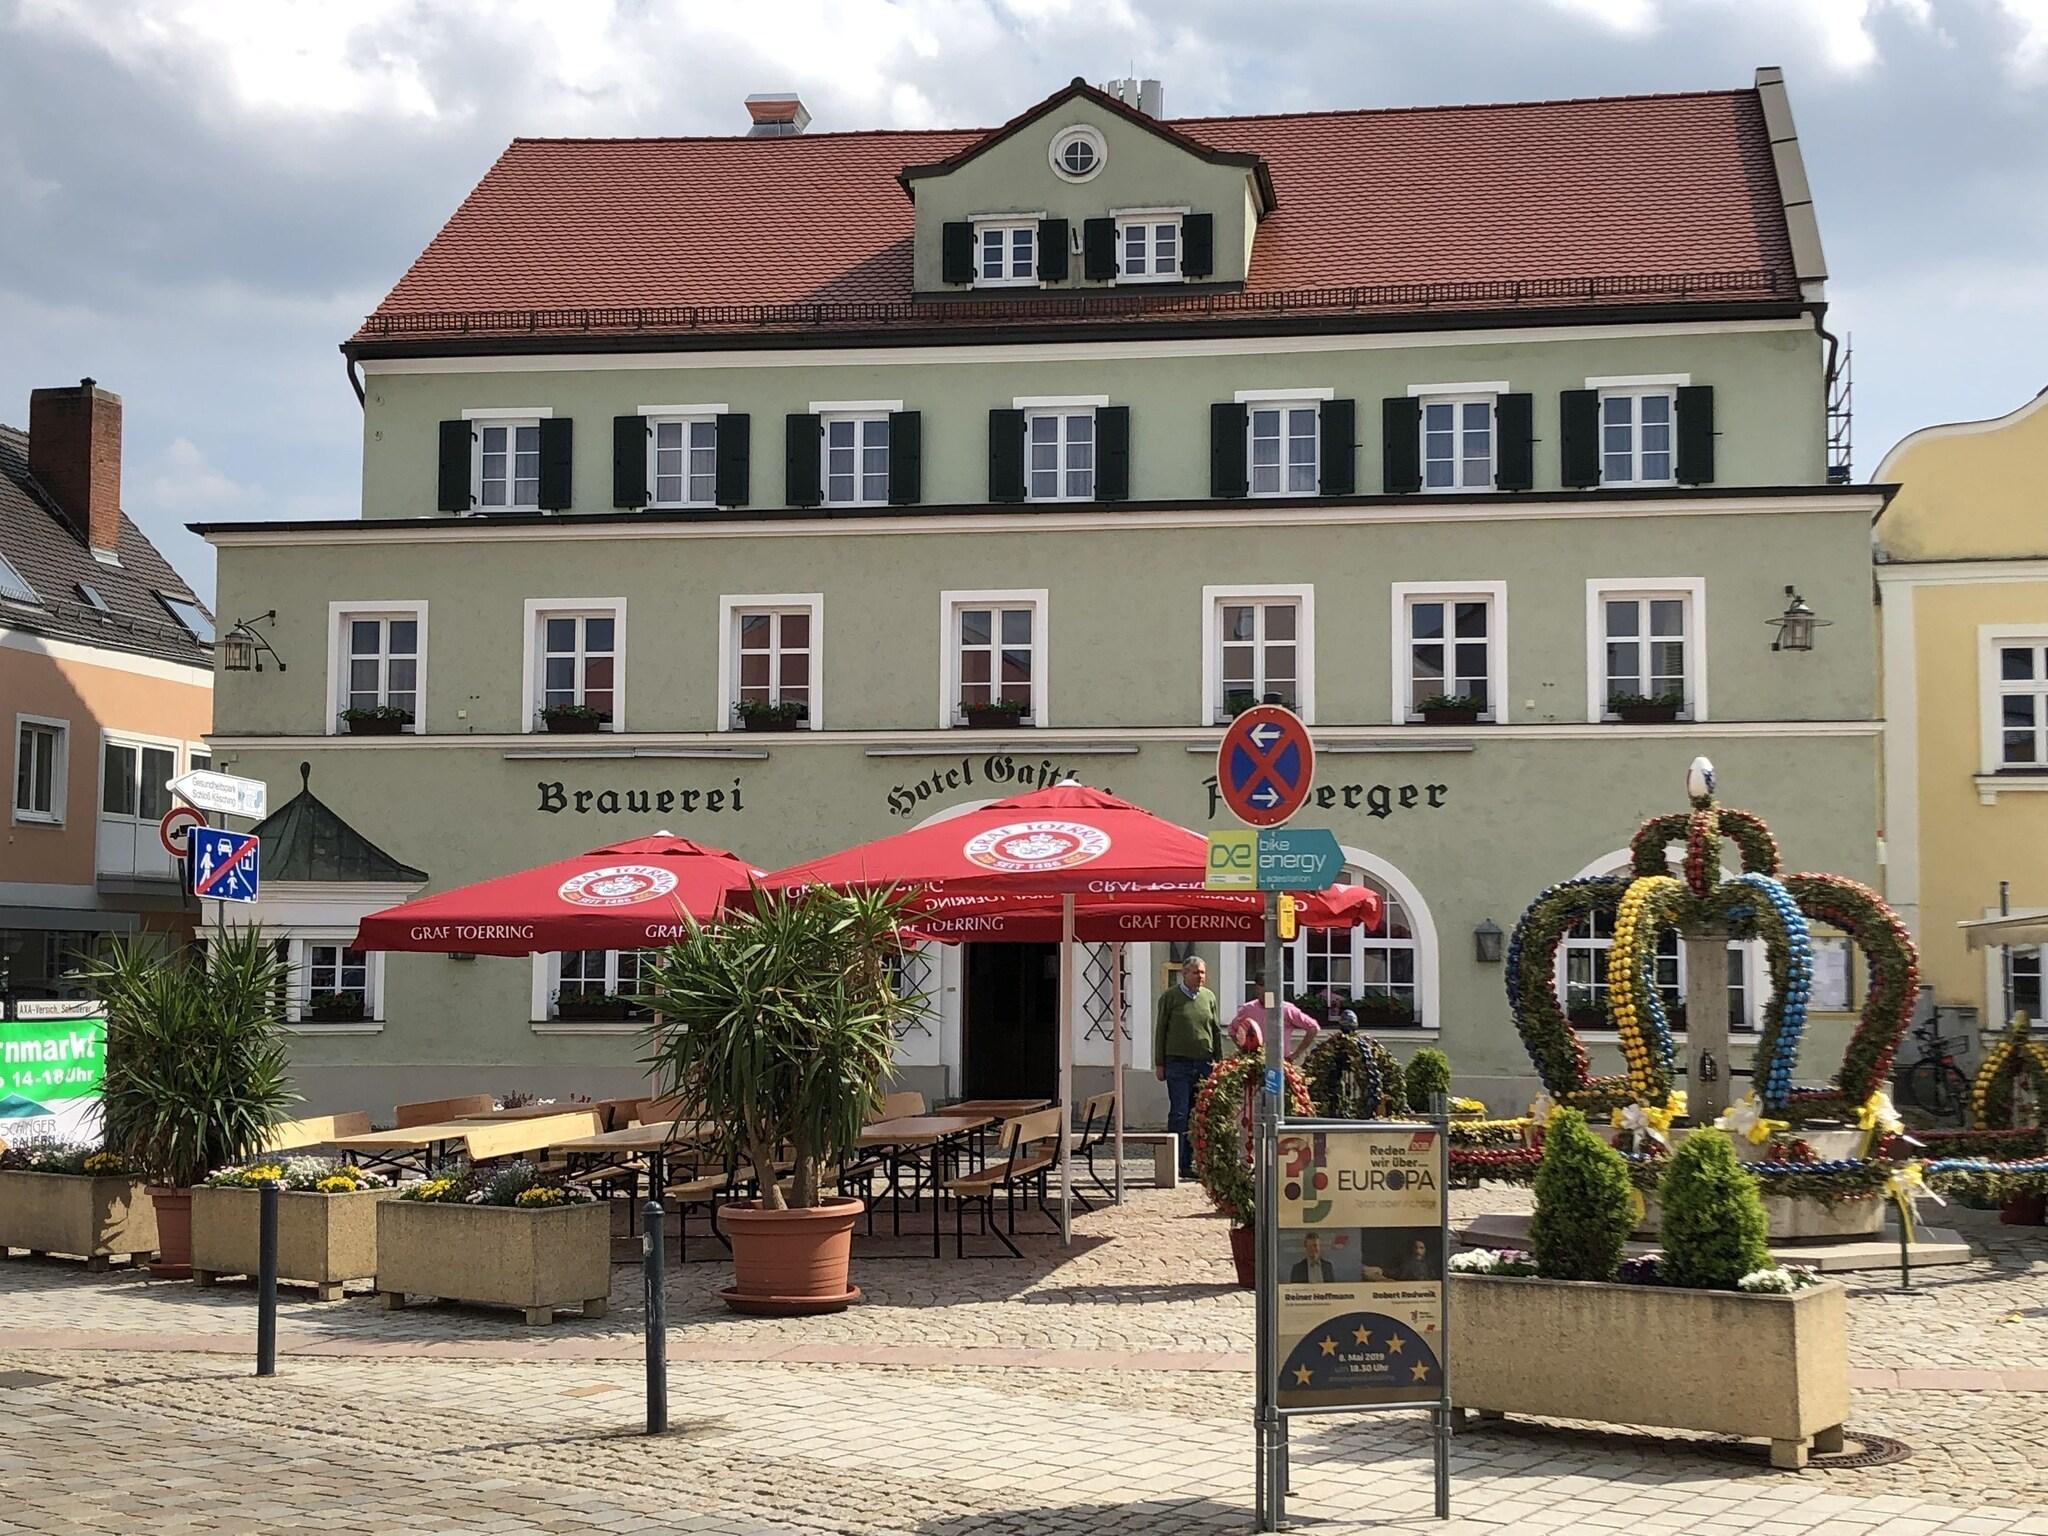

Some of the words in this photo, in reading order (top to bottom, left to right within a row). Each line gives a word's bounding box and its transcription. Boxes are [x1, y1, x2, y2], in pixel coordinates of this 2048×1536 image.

[537, 777, 744, 814] Brauerei
[887, 758, 973, 818] Hotel
[970, 828, 1013, 852] GRAF
[1025, 823, 1104, 853] TOERRING
[1259, 838, 1290, 851] bike
[993, 860, 1025, 870] SEIT
[1259, 854, 1327, 873] energy
[564, 872, 603, 891] GRAF
[615, 867, 674, 892] TOERRING
[1119, 914, 1161, 929] GRAF
[1167, 914, 1251, 930] TOERRING
[411, 926, 451, 941] GRAF
[454, 924, 535, 940] TOERRING
[0, 1031, 97, 1064] nmarkt
[12, 1068, 64, 1088] 14-18
[1370, 1145, 1406, 1156] Reden
[1371, 1157, 1390, 1168] wir
[1338, 1169, 1436, 1191] EUROPA
[1285, 1293, 1312, 1301] Reiner
[1313, 1292, 1355, 1301] Hoffmann
[1372, 1291, 1400, 1299] Robert
[1348, 1352, 1364, 1361] Mai
[1365, 1352, 1386, 1361] 2019
[1373, 1363, 1389, 1372] Uhr
